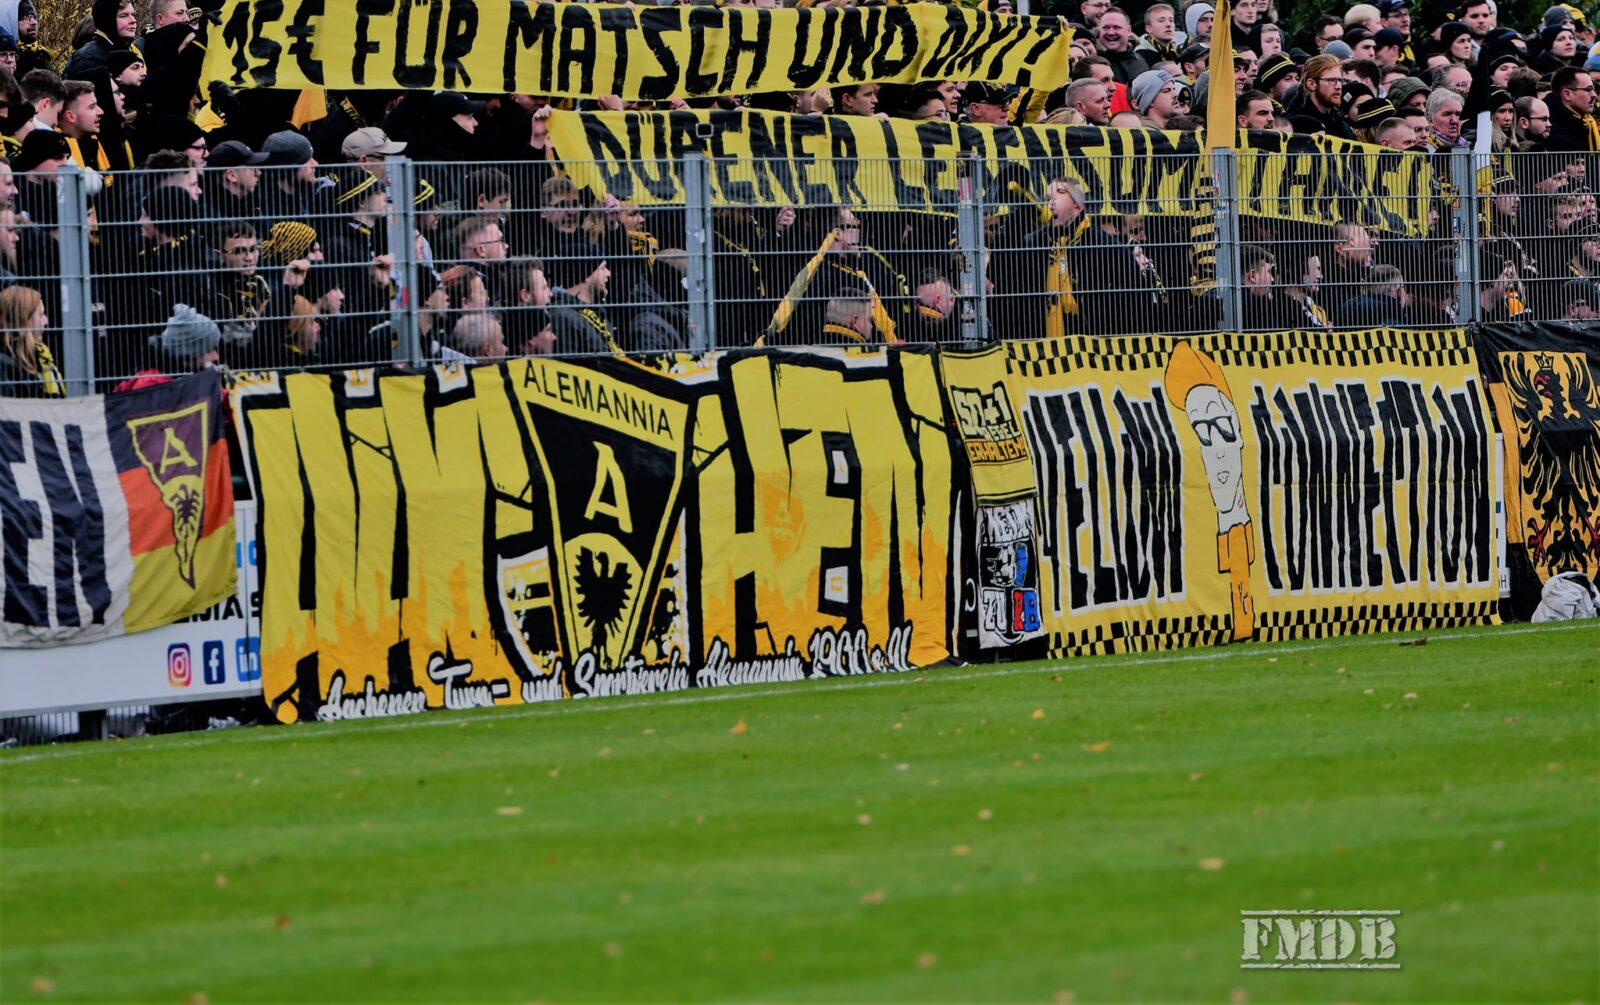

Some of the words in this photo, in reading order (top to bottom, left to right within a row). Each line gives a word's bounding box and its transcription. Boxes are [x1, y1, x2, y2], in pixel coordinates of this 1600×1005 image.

[222, 0, 325, 88] 15€
[352, 0, 479, 88] FÜR
[502, 0, 772, 100] MATSCH
[787, 5, 918, 87] UND
[524, 359, 673, 440] ALEMANNIA
[584, 440, 633, 533] A
[1022, 386, 1183, 611] YELLOW
[1250, 379, 1491, 591] CONNECTION
